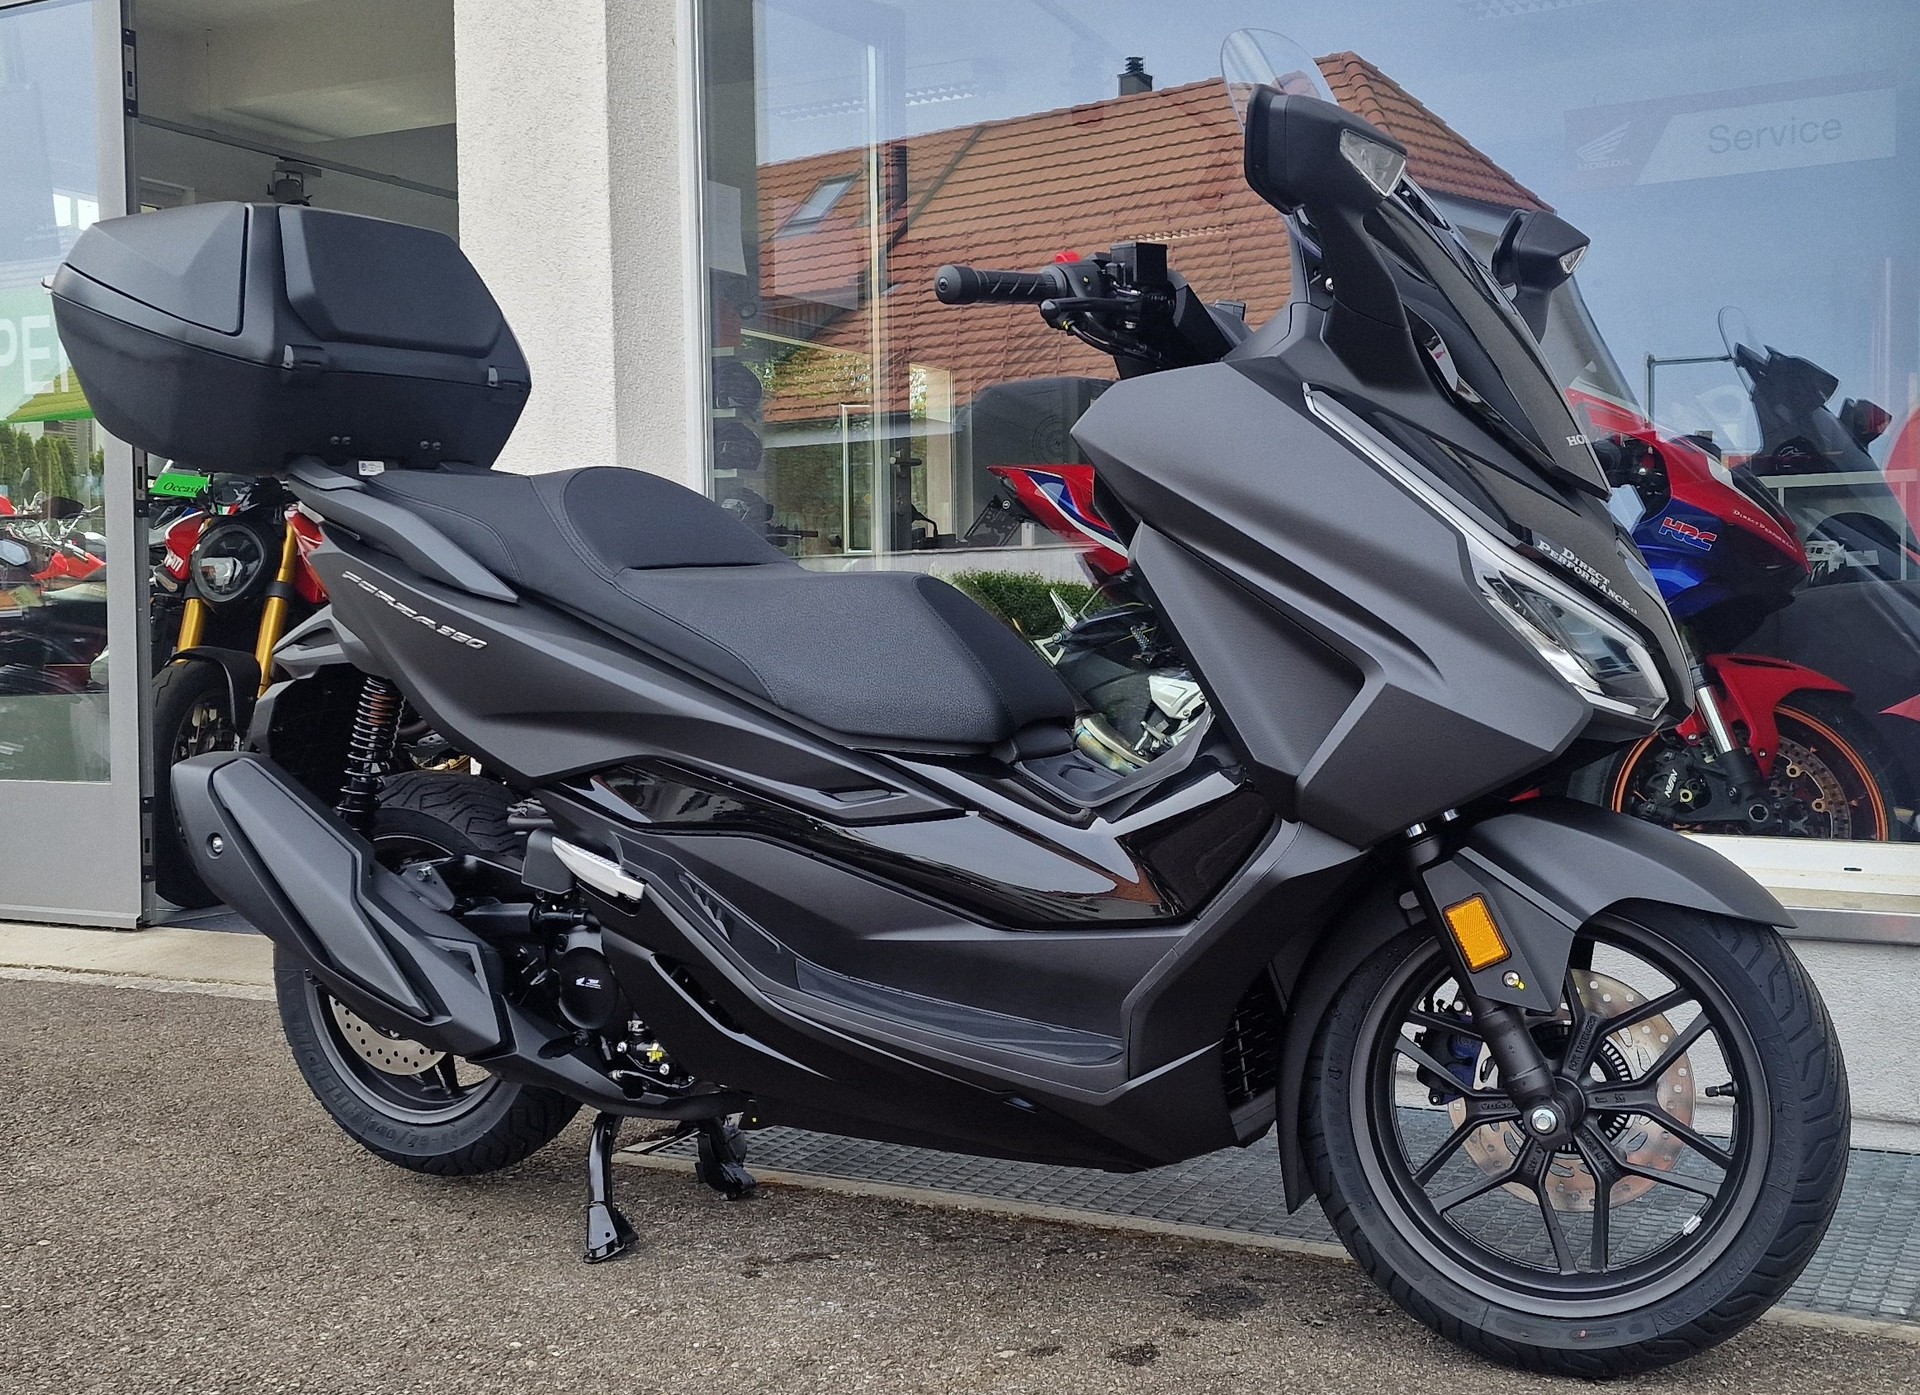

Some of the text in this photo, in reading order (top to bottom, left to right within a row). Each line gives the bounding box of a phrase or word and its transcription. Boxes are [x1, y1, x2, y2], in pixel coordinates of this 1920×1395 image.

[1708, 117, 1842, 154] Service
[1579, 158, 1633, 170] HONDA
[1658, 516, 1718, 551] HRC
[1561, 547, 1611, 585] DIRECT
[292, 1021, 363, 1122] MICHELIN
